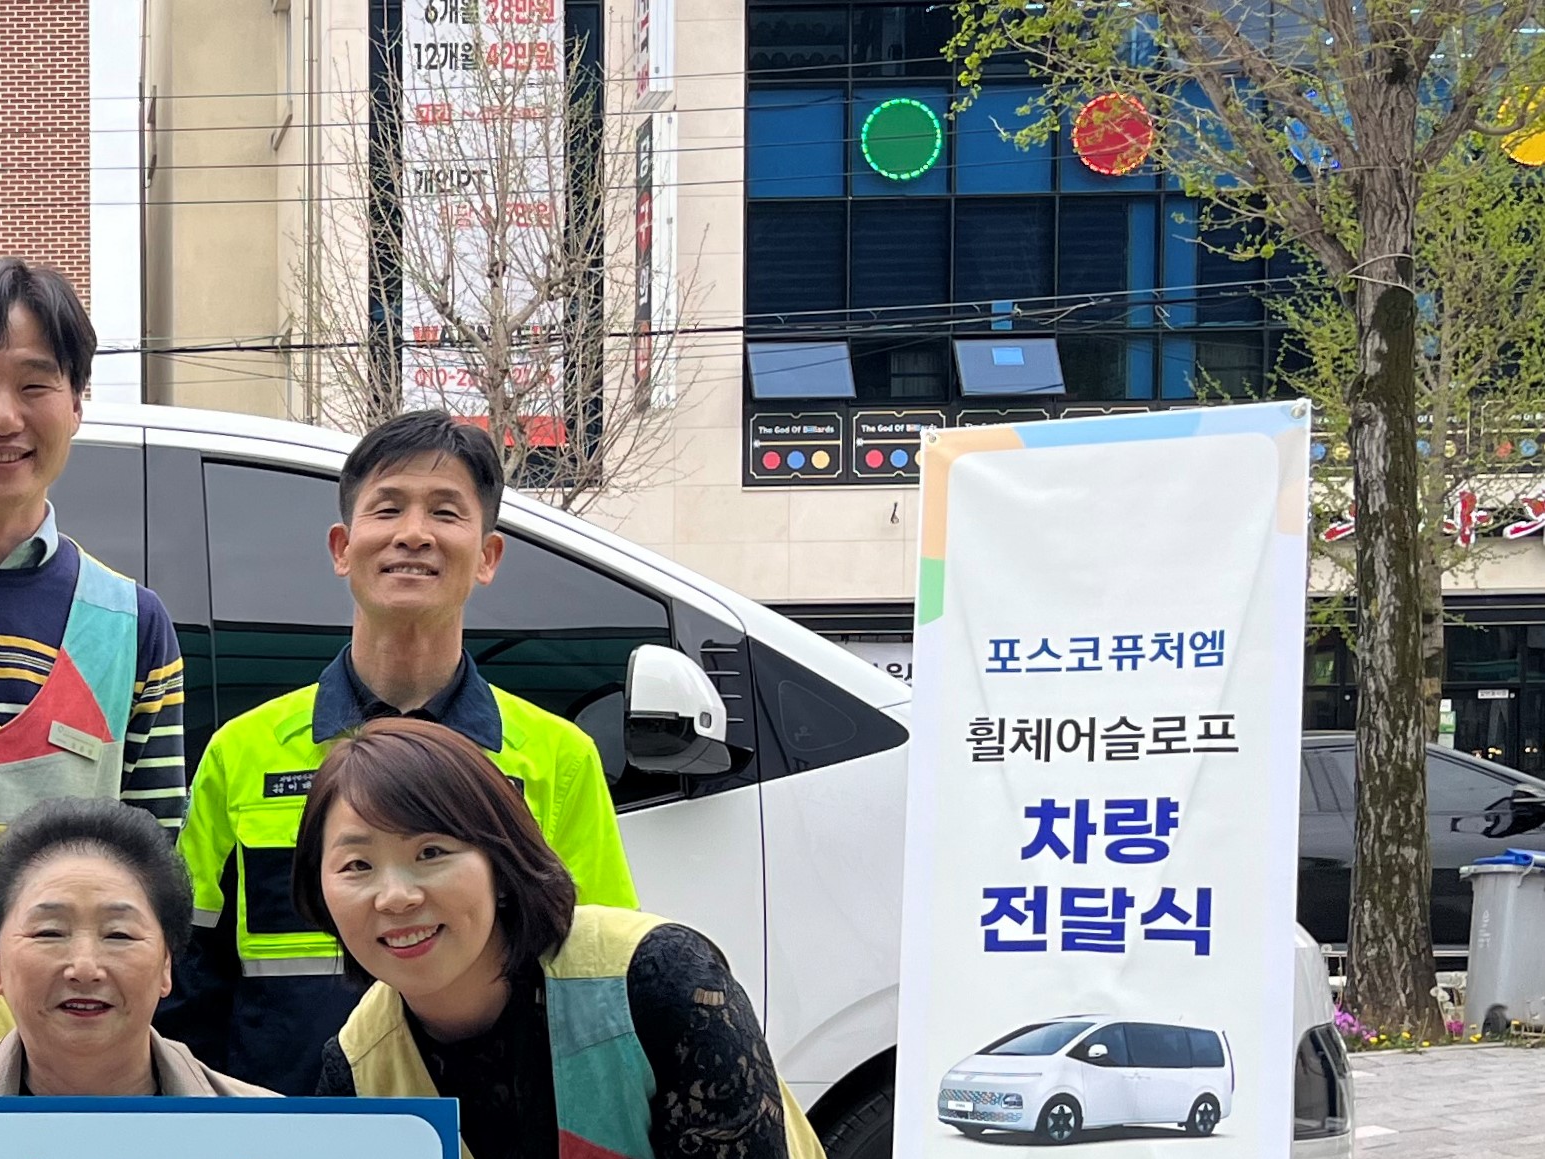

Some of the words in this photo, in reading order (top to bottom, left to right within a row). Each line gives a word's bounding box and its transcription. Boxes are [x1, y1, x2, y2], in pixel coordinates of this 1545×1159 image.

[758, 426, 772, 434] The
[774, 426, 789, 434] God
[791, 425, 801, 433] Of
[861, 424, 876, 432] The
[877, 424, 893, 432] God
[894, 423, 904, 432] Of
[985, 629, 1226, 674] 포스코퓨처엠
[964, 713, 1240, 763] 휠체어슬로프
[1020, 796, 1179, 864] 차량
[980, 885, 1213, 957] 전달식
